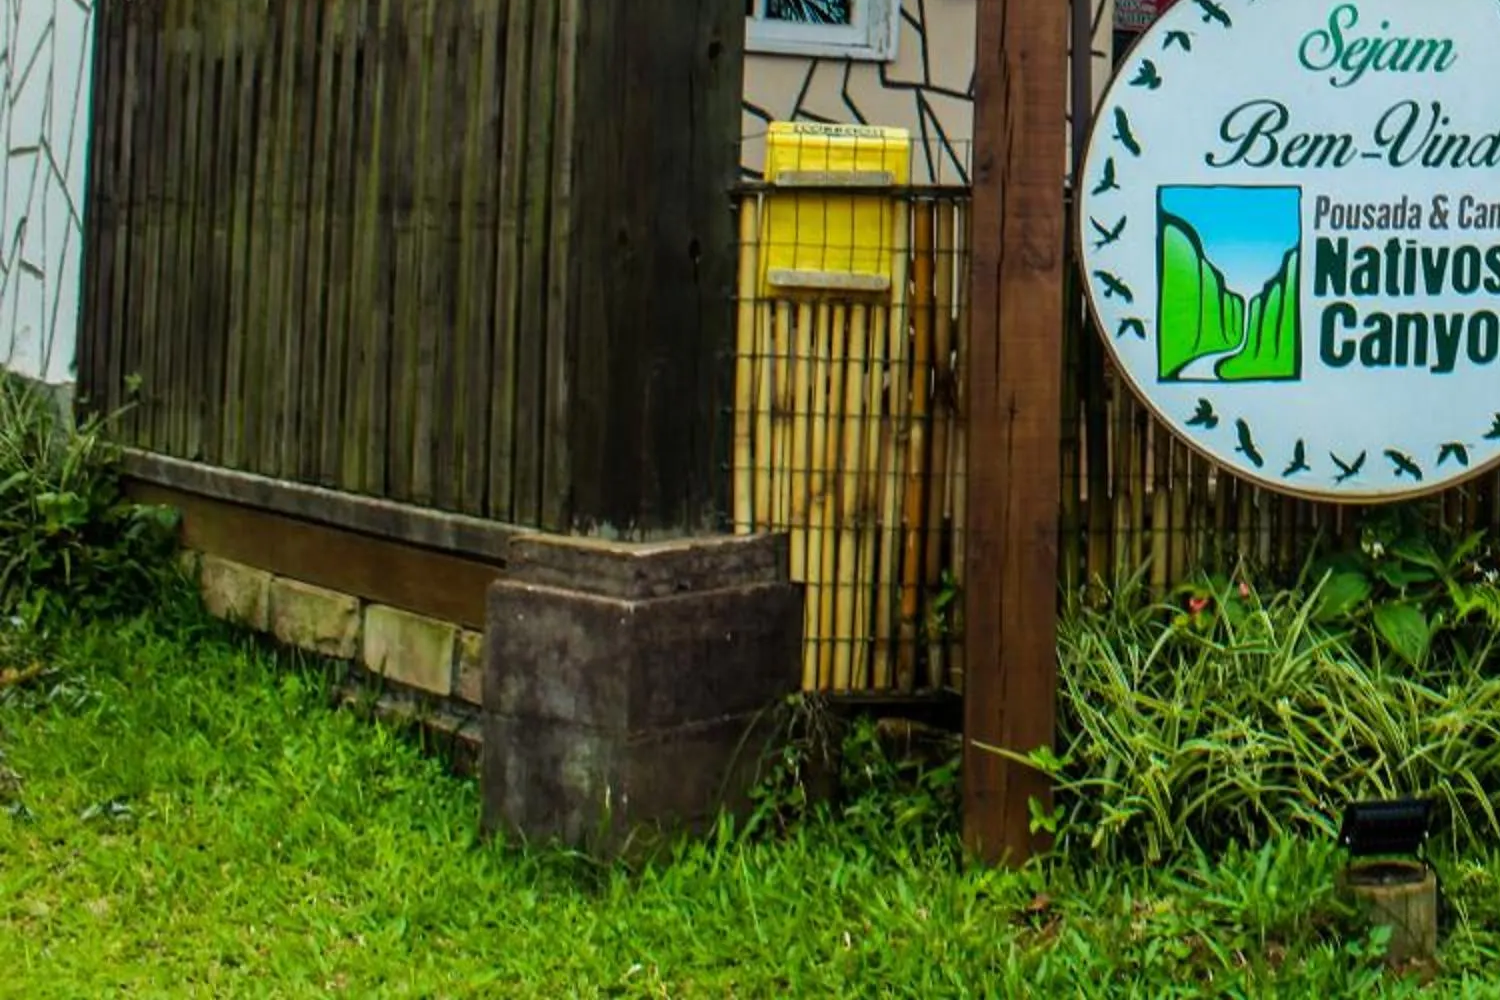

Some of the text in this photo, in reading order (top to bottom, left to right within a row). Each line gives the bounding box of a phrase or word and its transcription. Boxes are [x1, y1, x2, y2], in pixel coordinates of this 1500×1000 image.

[1299, 4, 1457, 87] Sejam
[1315, 196, 1422, 231] Pousada
[1429, 195, 1449, 230] &
